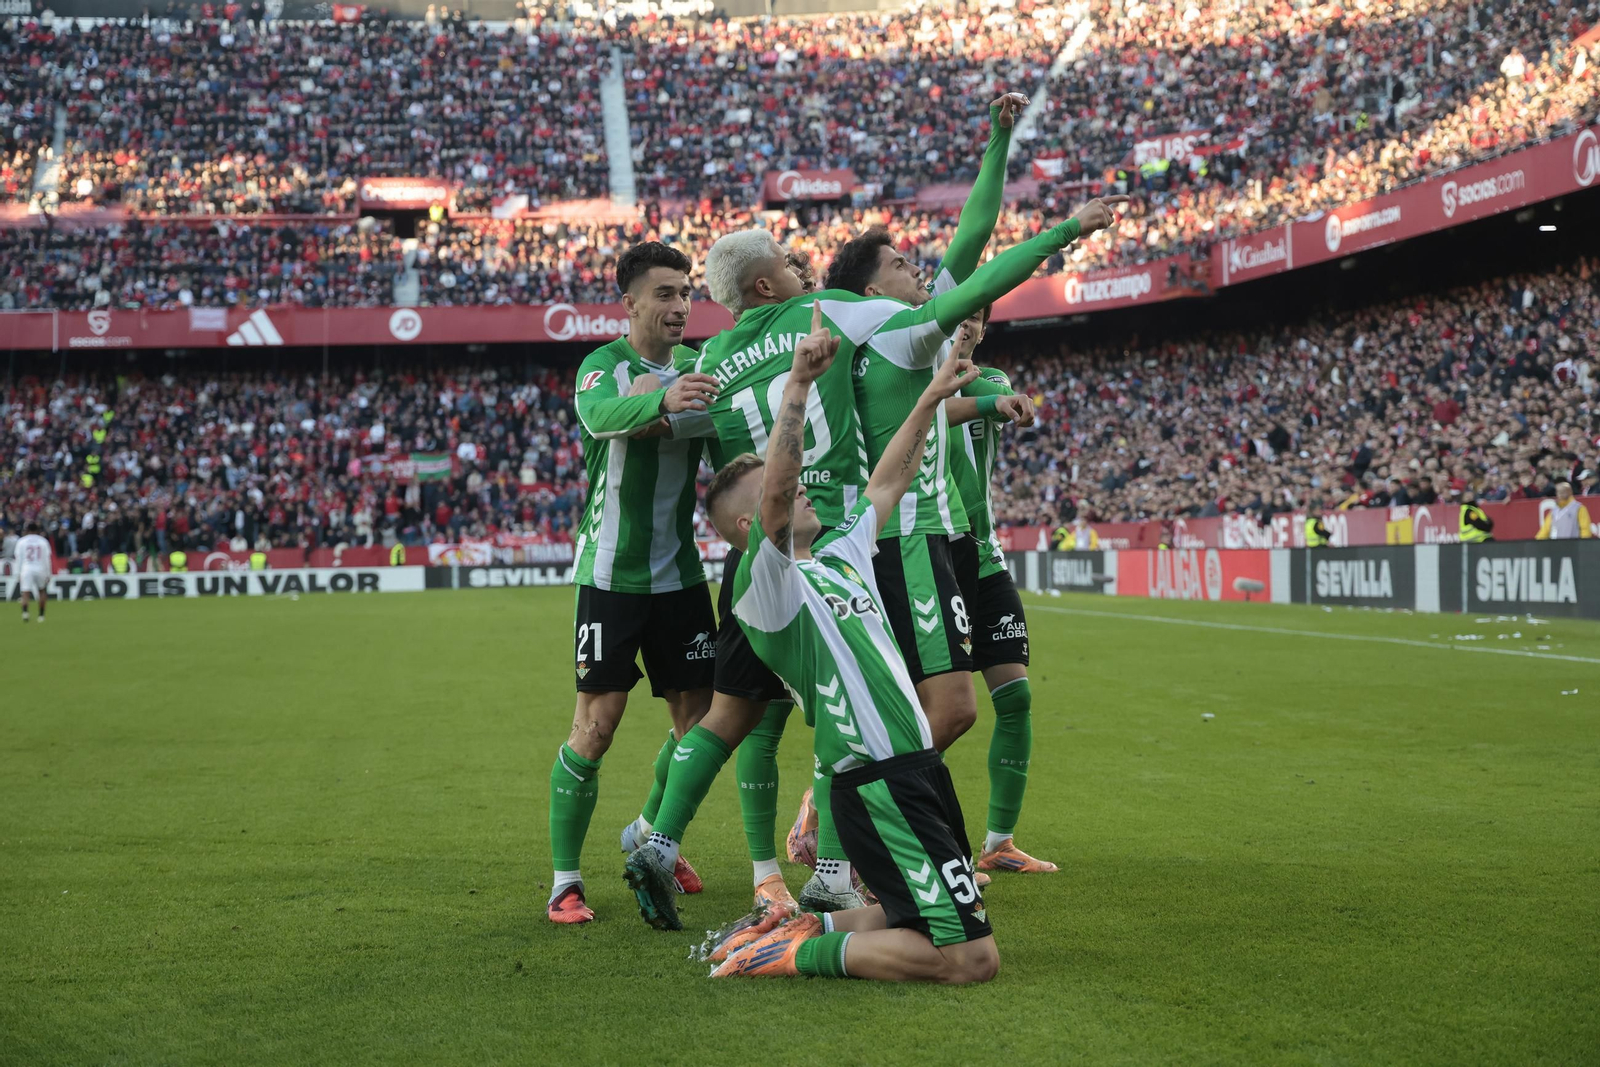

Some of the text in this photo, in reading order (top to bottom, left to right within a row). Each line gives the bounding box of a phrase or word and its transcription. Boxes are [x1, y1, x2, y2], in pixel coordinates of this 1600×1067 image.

[139, 577, 187, 597] ES
[197, 576, 248, 597] UN
[258, 572, 379, 595] VALOR
[1053, 558, 1093, 586] SEVILLA
[1148, 549, 1203, 600] LALIGA
[1316, 559, 1393, 598] SEVILLA
[1476, 556, 1578, 603] SEVILLA
[950, 595, 969, 634] 8
[1006, 622, 1026, 631] AUS
[577, 622, 602, 662] 21
[701, 641, 718, 651] AU
[740, 781, 776, 790] BETIS
